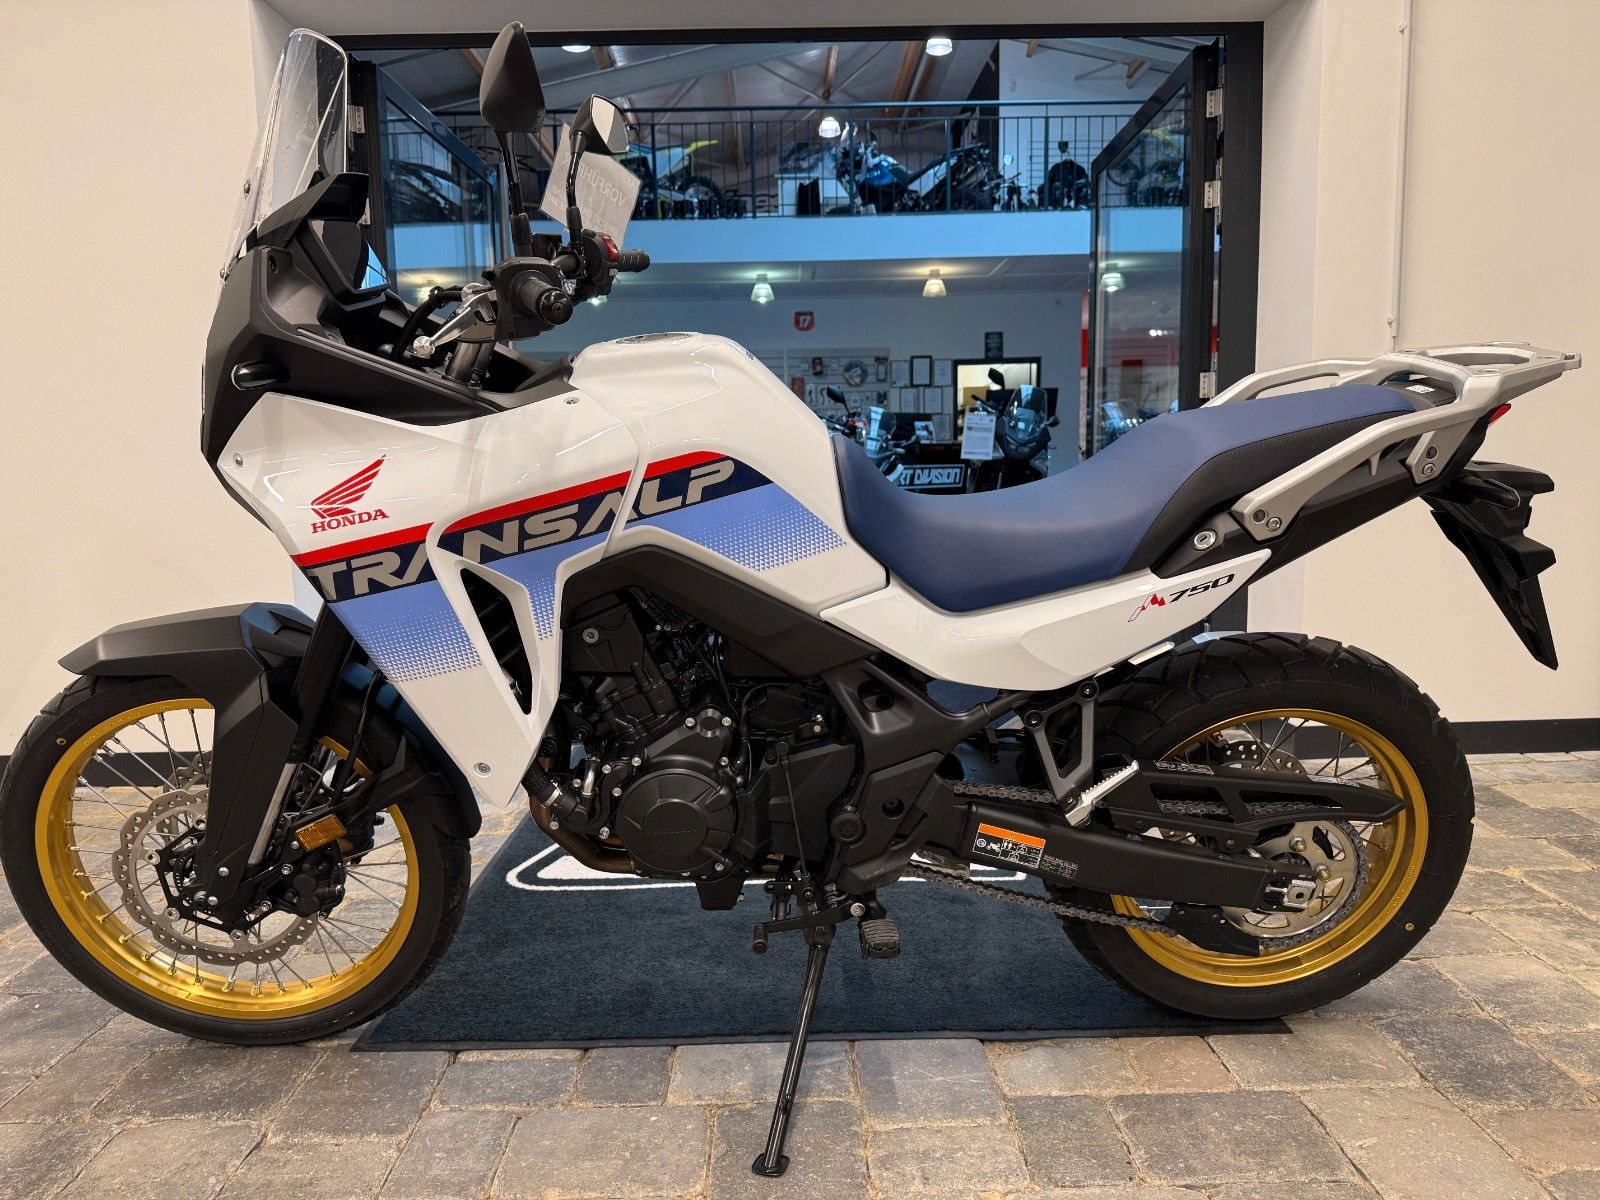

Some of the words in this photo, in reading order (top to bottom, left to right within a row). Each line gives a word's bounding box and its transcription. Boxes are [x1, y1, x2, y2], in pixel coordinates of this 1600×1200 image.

[914, 468, 960, 484] DIVISION
[308, 459, 735, 600] TRANSALP
[311, 508, 389, 534] HONDA
[1169, 573, 1235, 603] 750
